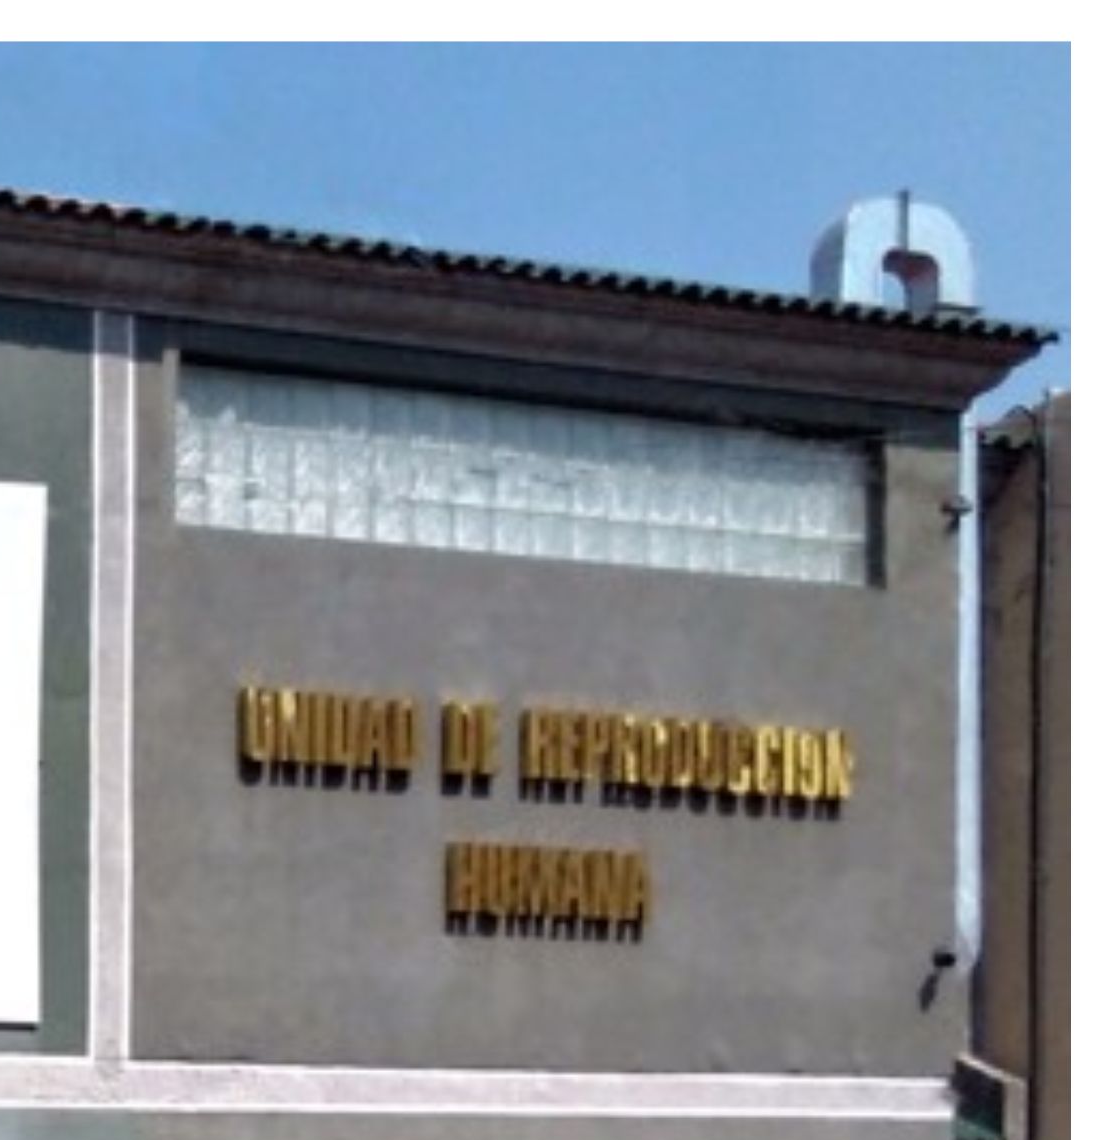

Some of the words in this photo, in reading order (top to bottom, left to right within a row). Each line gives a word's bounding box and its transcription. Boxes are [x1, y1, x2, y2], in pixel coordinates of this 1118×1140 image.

[237, 687, 416, 775] UNIDAD
[441, 699, 498, 779] DE
[519, 708, 852, 802] REPRODUCCION
[446, 843, 650, 926] HUMANA
